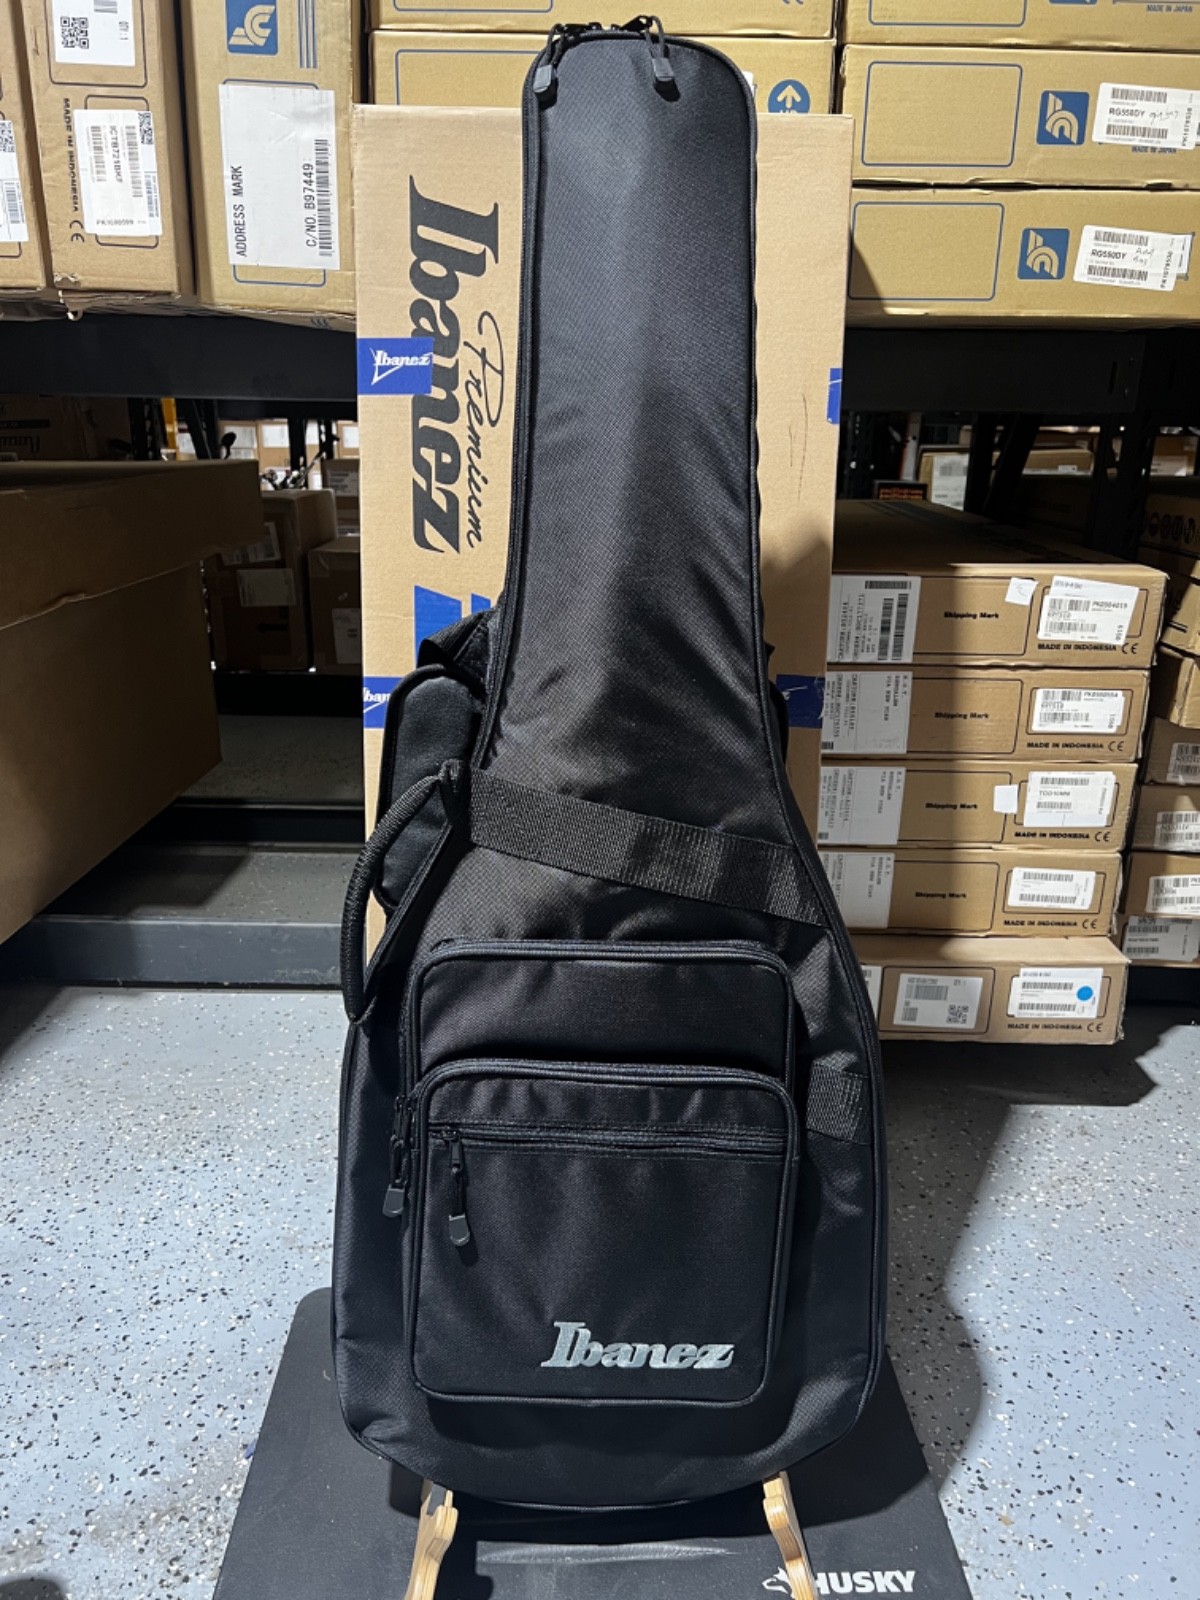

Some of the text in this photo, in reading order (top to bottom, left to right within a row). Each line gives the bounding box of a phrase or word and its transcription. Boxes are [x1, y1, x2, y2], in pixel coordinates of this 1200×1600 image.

[63, 98, 79, 212] MADE IN INDONESIA
[232, 165, 248, 258] ADDRESS MARK
[302, 163, 318, 248] C/NO. B97449
[373, 350, 432, 366] Ibanez
[408, 175, 499, 555] Ibanez
[465, 310, 505, 549] Premium
[943, 610, 999, 622] Shipping Mark
[1073, 644, 1117, 652] INDONESIA
[934, 711, 989, 721] Shipping Mark
[1062, 742, 1104, 750] INDONESIA
[925, 802, 958, 812] Shipping
[1014, 831, 1037, 839] MADE
[1049, 832, 1090, 840] INDONESIA
[915, 891, 967, 901] Shipping Mark
[1004, 919, 1026, 927] MADE
[1041, 1023, 1082, 1031] INDONESIA
[540, 1320, 735, 1371] Ibanez
[814, 1570, 916, 1595] HUSKY
